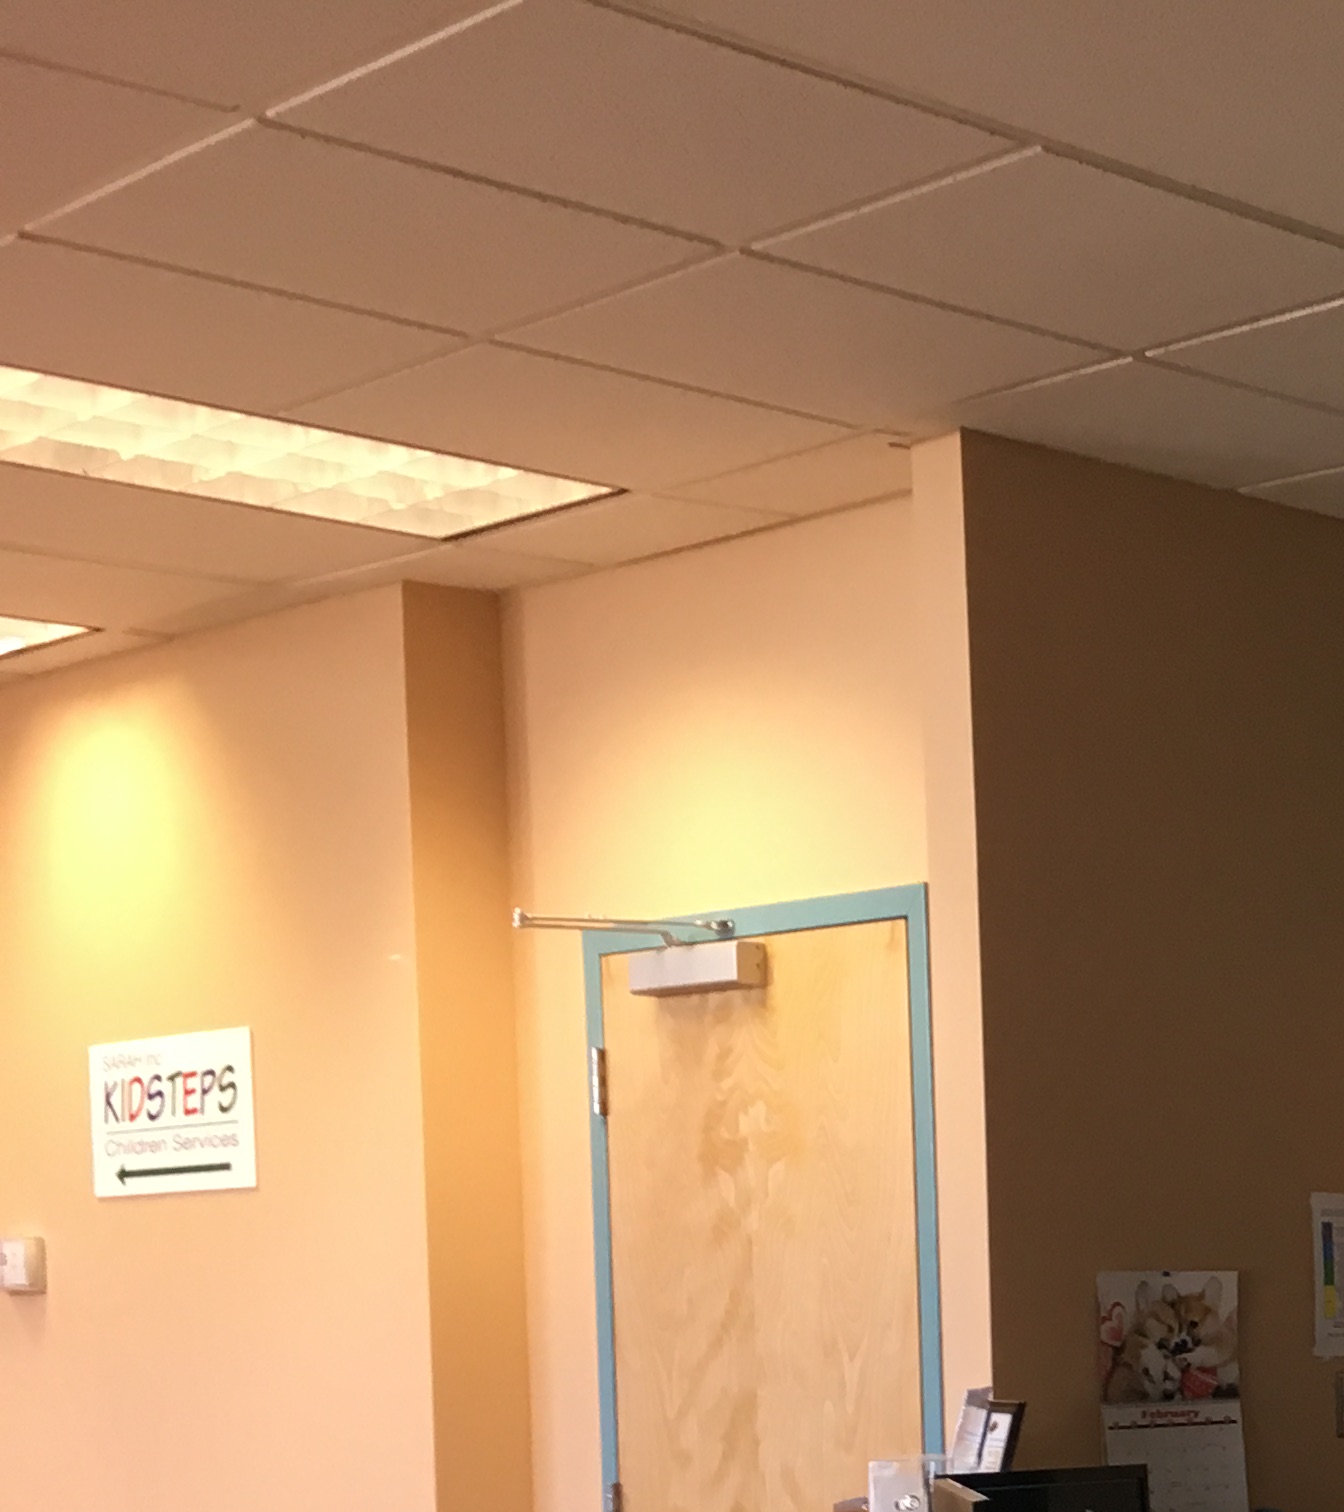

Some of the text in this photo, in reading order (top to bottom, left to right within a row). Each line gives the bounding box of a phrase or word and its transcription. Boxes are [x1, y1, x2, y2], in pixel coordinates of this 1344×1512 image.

[104, 1064, 238, 1125] KIDSTEPS
[104, 1133, 240, 1158] Children Services
[1140, 1408, 1201, 1419] February
